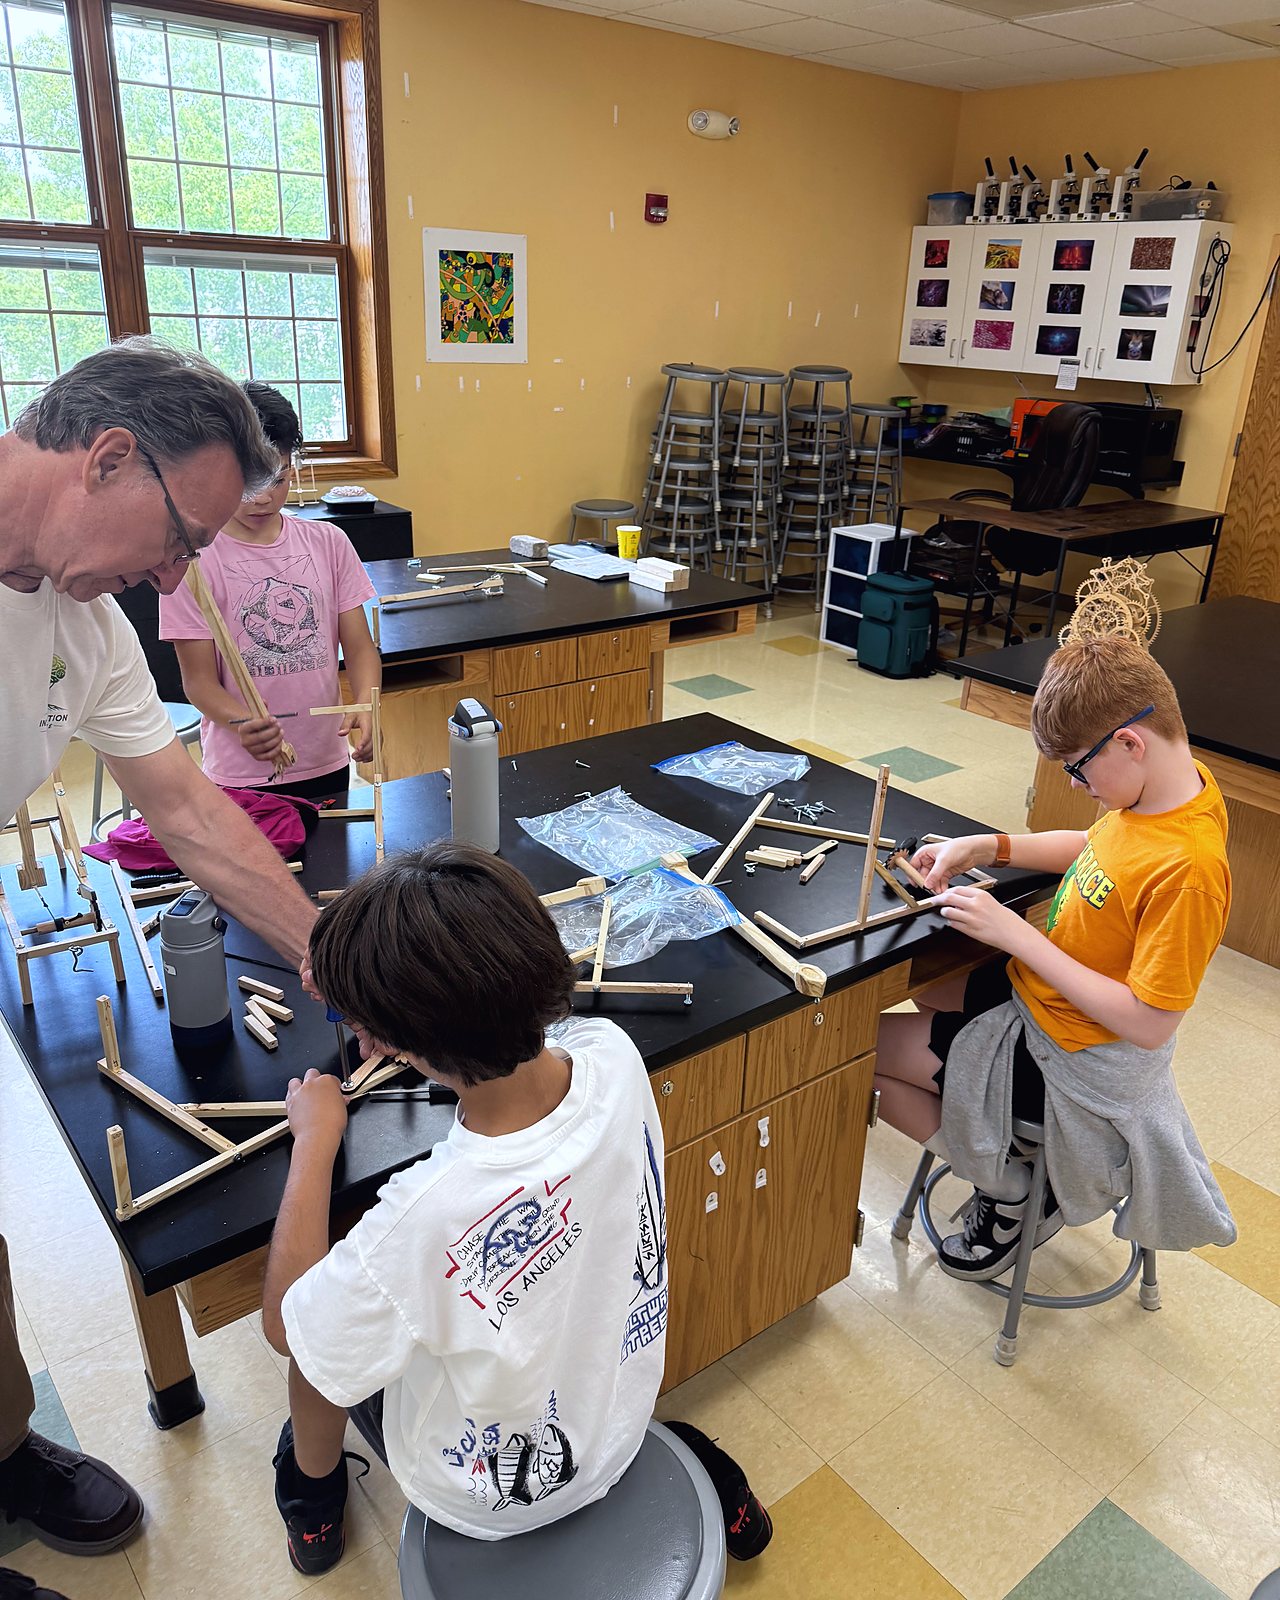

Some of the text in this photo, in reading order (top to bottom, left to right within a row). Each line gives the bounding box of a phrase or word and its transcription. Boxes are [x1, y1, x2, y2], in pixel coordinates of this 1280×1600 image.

[457, 1195, 538, 1261] CHASE THE WAVE
[486, 1247, 518, 1273] BREAKS
[541, 1213, 555, 1227] THE
[488, 1222, 583, 1335] LOS ANGELES
